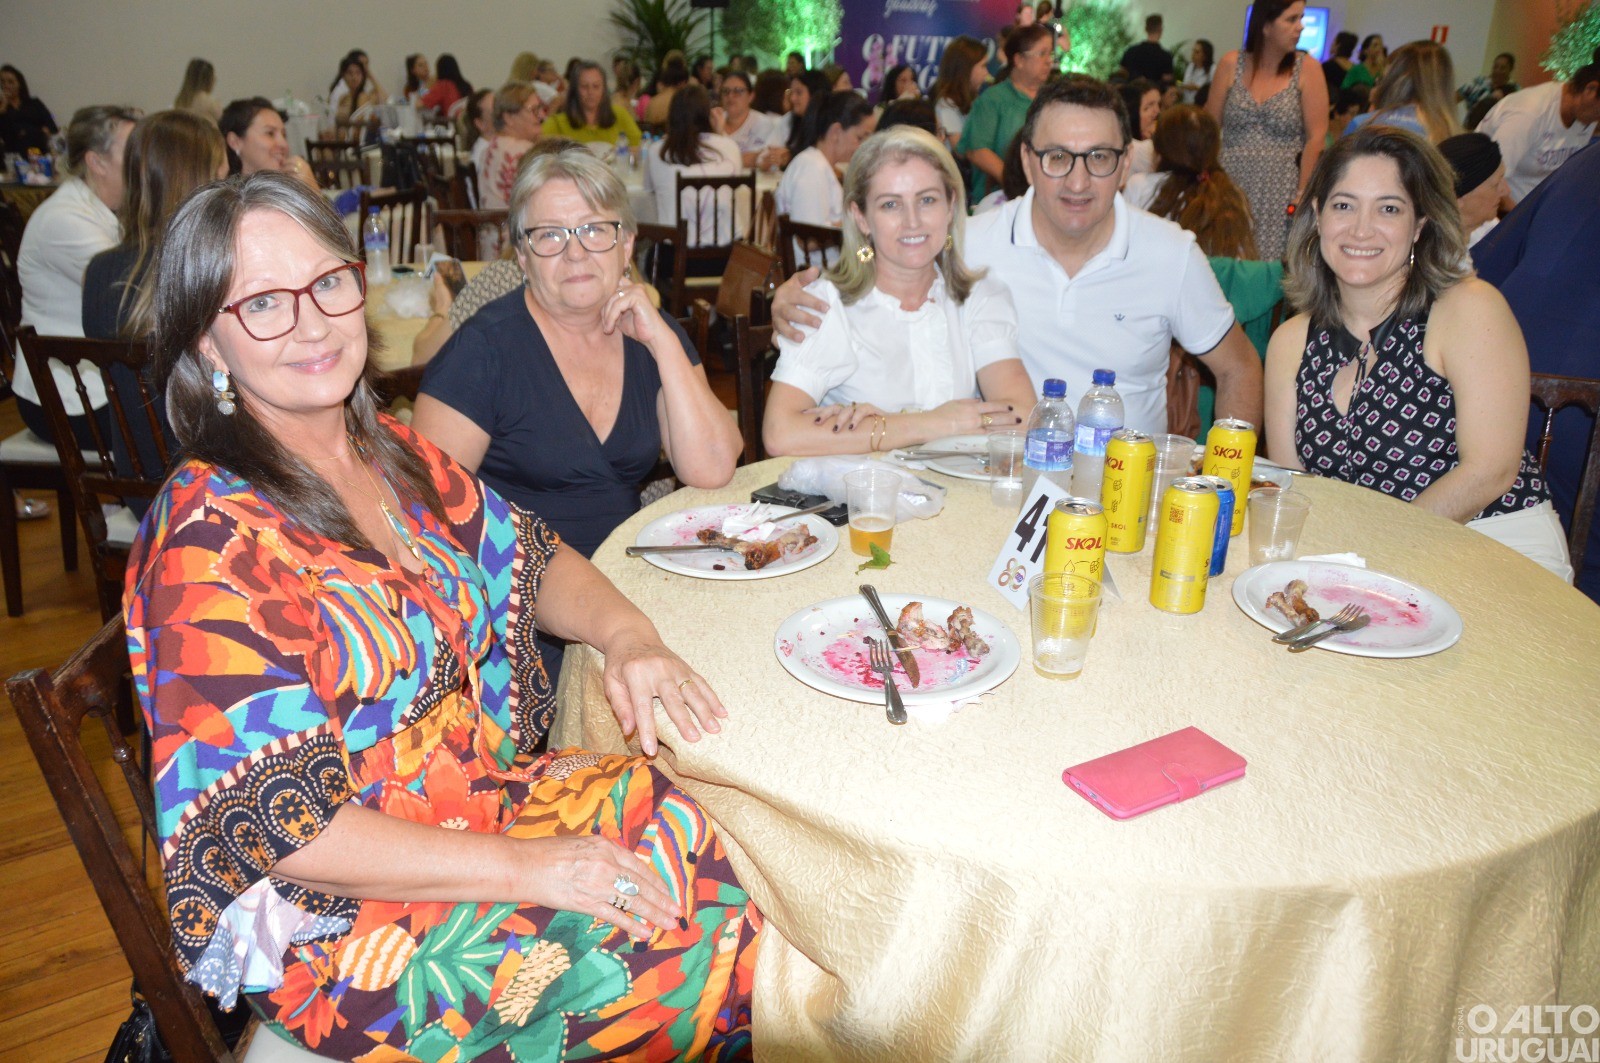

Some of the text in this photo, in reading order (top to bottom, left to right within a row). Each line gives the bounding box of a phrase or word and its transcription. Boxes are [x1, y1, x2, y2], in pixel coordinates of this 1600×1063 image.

[1213, 445, 1243, 459] SKOL
[1104, 456, 1125, 471] KOL
[1065, 536, 1102, 550] SKOL
